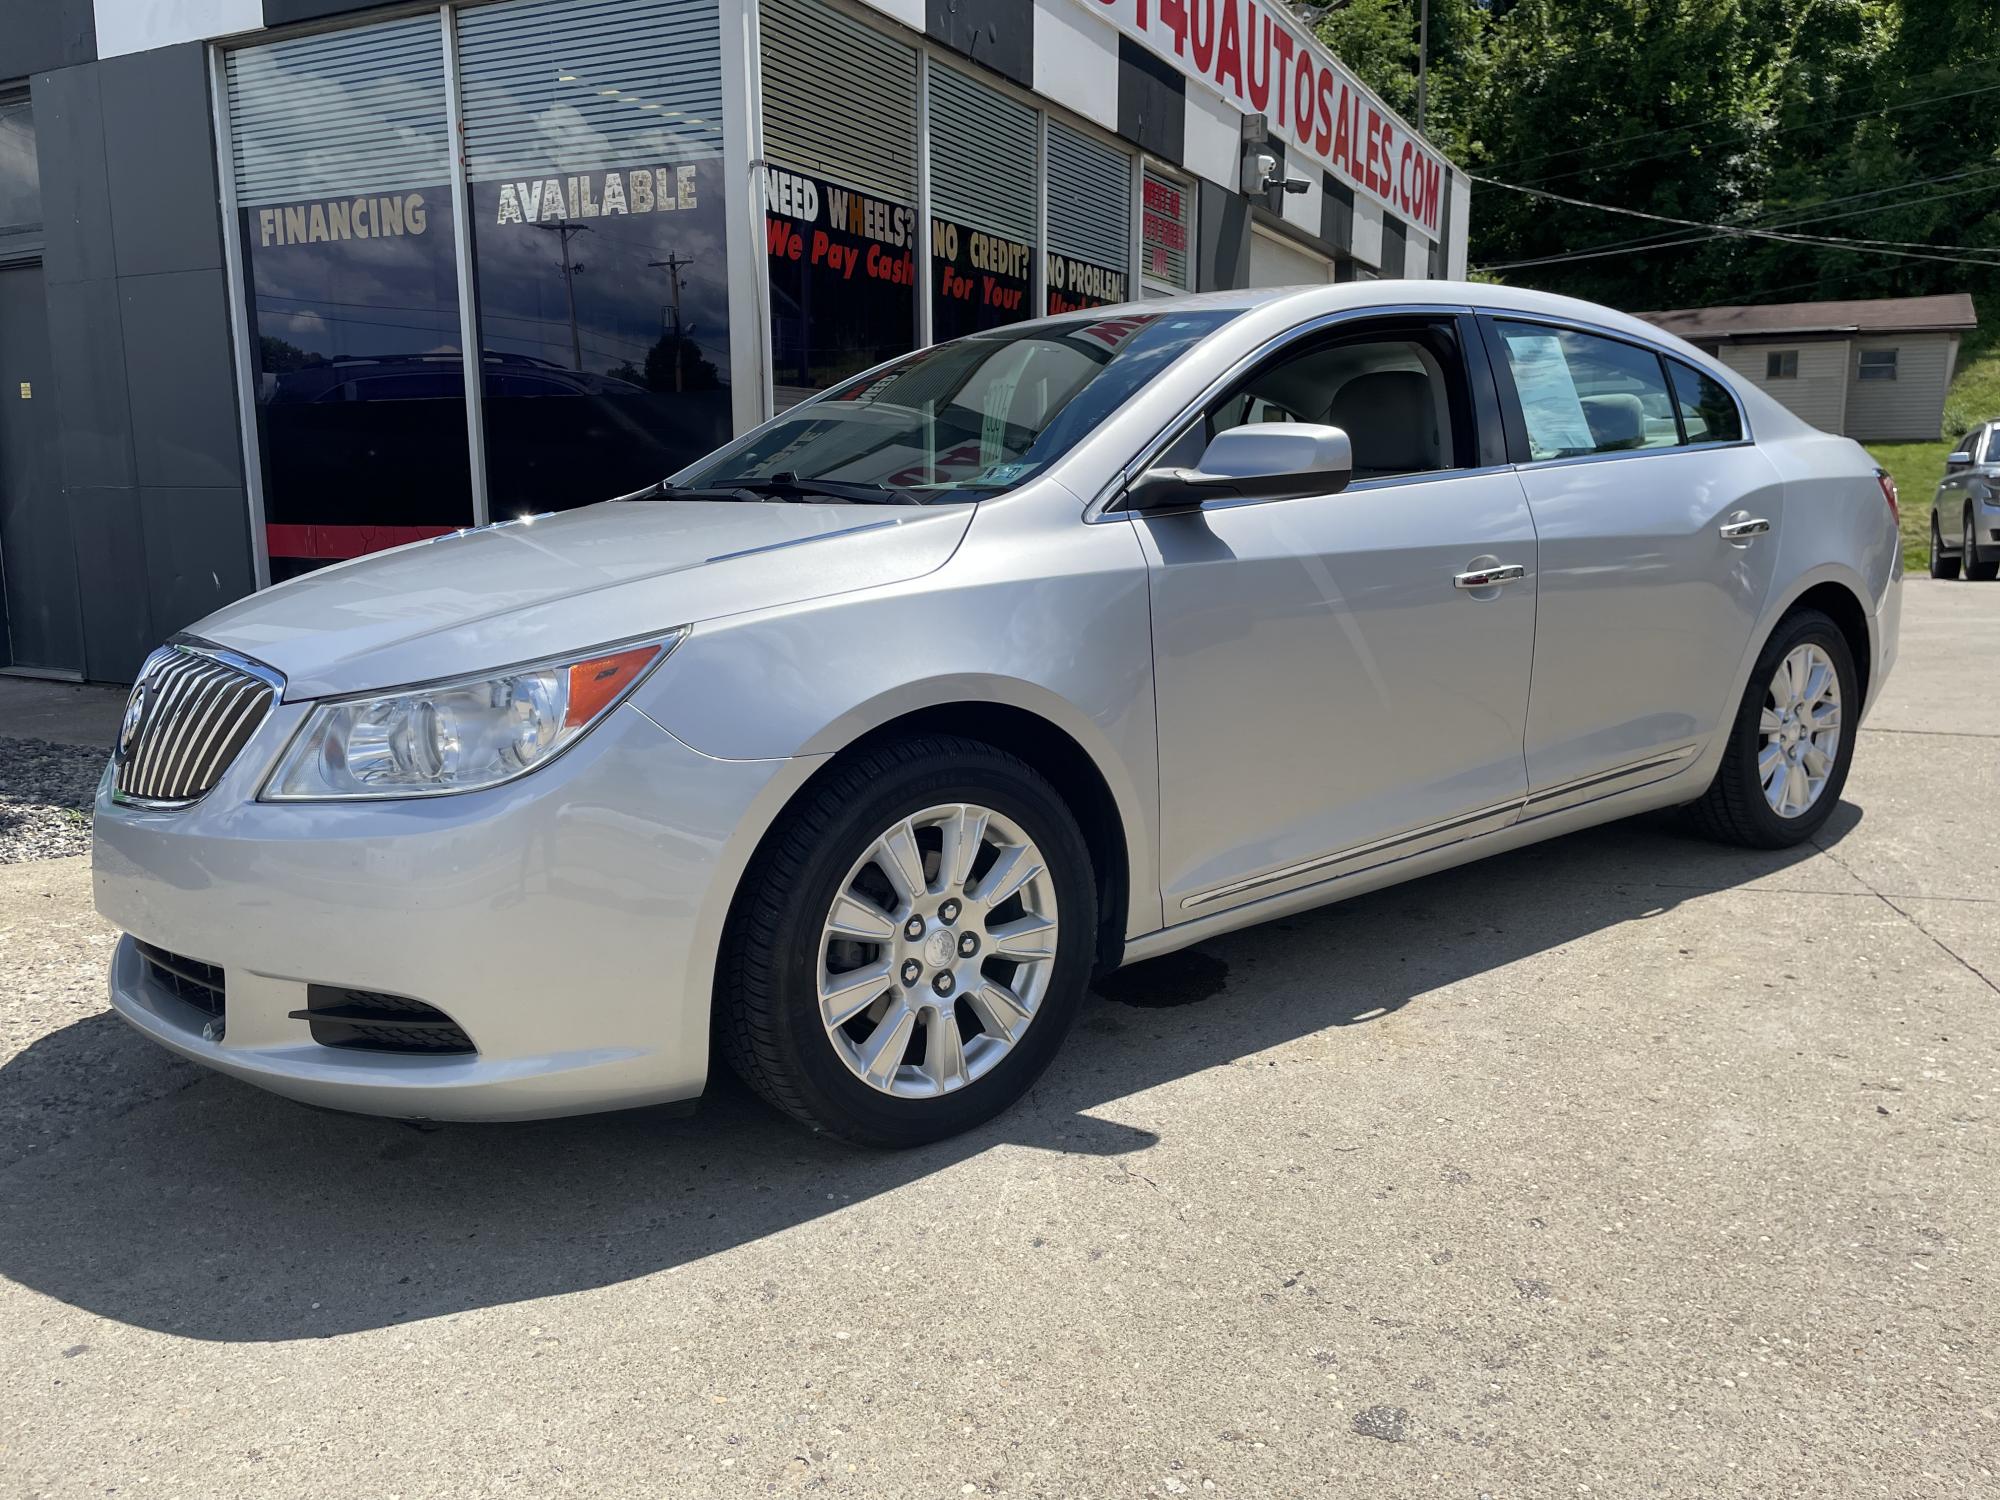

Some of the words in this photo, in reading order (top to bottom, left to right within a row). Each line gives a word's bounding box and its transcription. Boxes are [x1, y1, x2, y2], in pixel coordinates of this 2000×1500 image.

[1098, 0, 1440, 231] 40AUTOSALES.COM
[259, 193, 427, 247] FINANCING
[497, 165, 698, 225] AVAILABLE
[763, 167, 819, 222] NEED
[826, 186, 915, 250] WHEELS?
[766, 217, 803, 261] We
[811, 230, 859, 279] Pay
[866, 244, 914, 286] Cash
[932, 219, 958, 262] NO
[970, 231, 1030, 281] CREDIT?
[1047, 253, 1065, 289] NO
[1068, 260, 1124, 304] PROBLEM!
[942, 265, 974, 300] For
[983, 275, 1023, 310] Your
